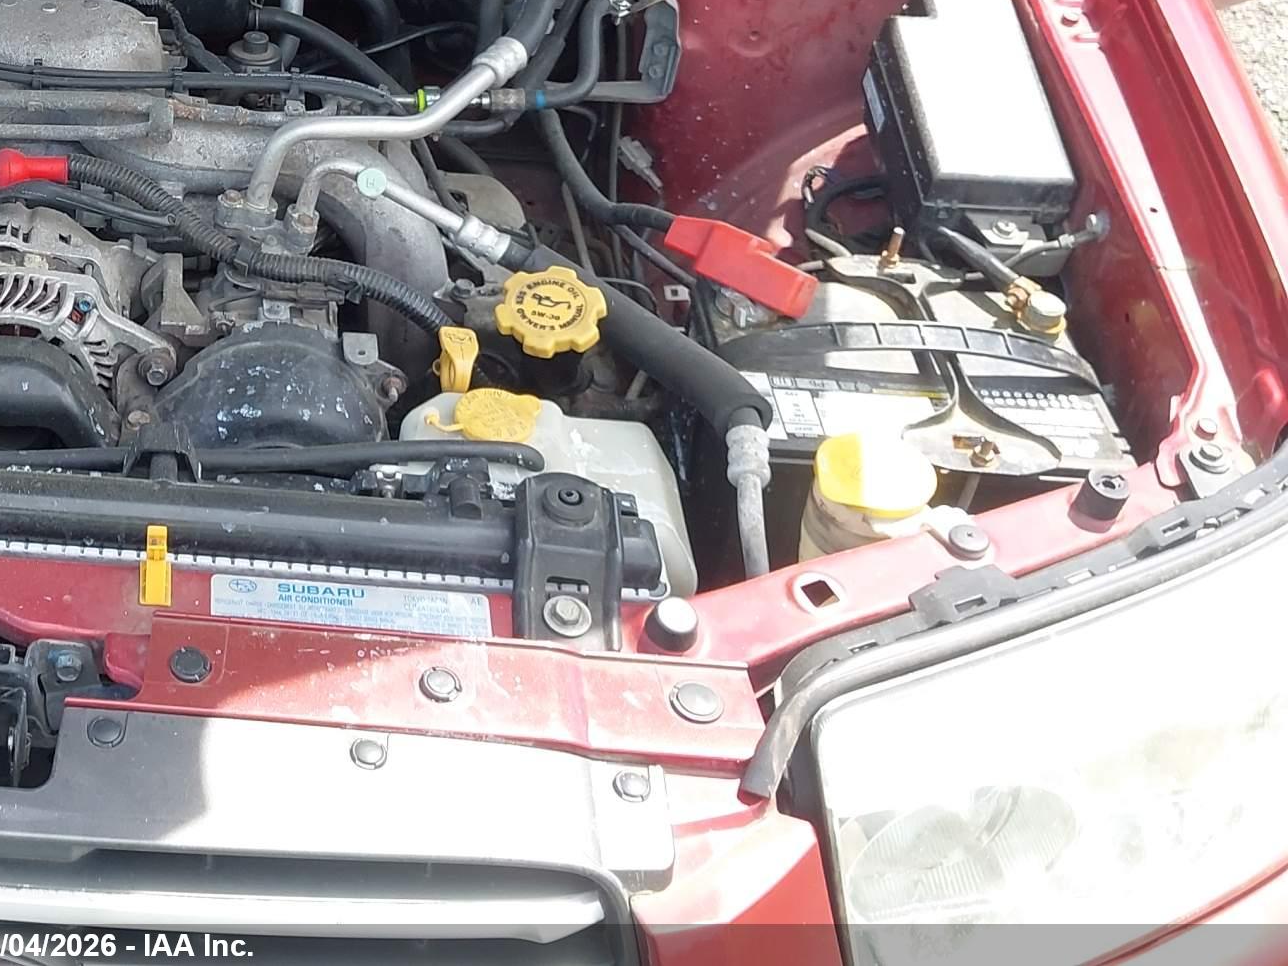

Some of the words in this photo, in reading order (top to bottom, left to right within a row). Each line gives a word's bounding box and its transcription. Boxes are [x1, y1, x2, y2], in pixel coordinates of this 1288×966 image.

[526, 279, 565, 290] ENGINE
[567, 287, 581, 300] OIL
[516, 308, 556, 331] OWNER'S
[558, 304, 584, 330] MANUAL
[531, 310, 560, 321] 5W-30
[277, 582, 365, 598] SUBARU
[278, 594, 293, 603] AIR
[294, 595, 354, 606] CONDITIONER
